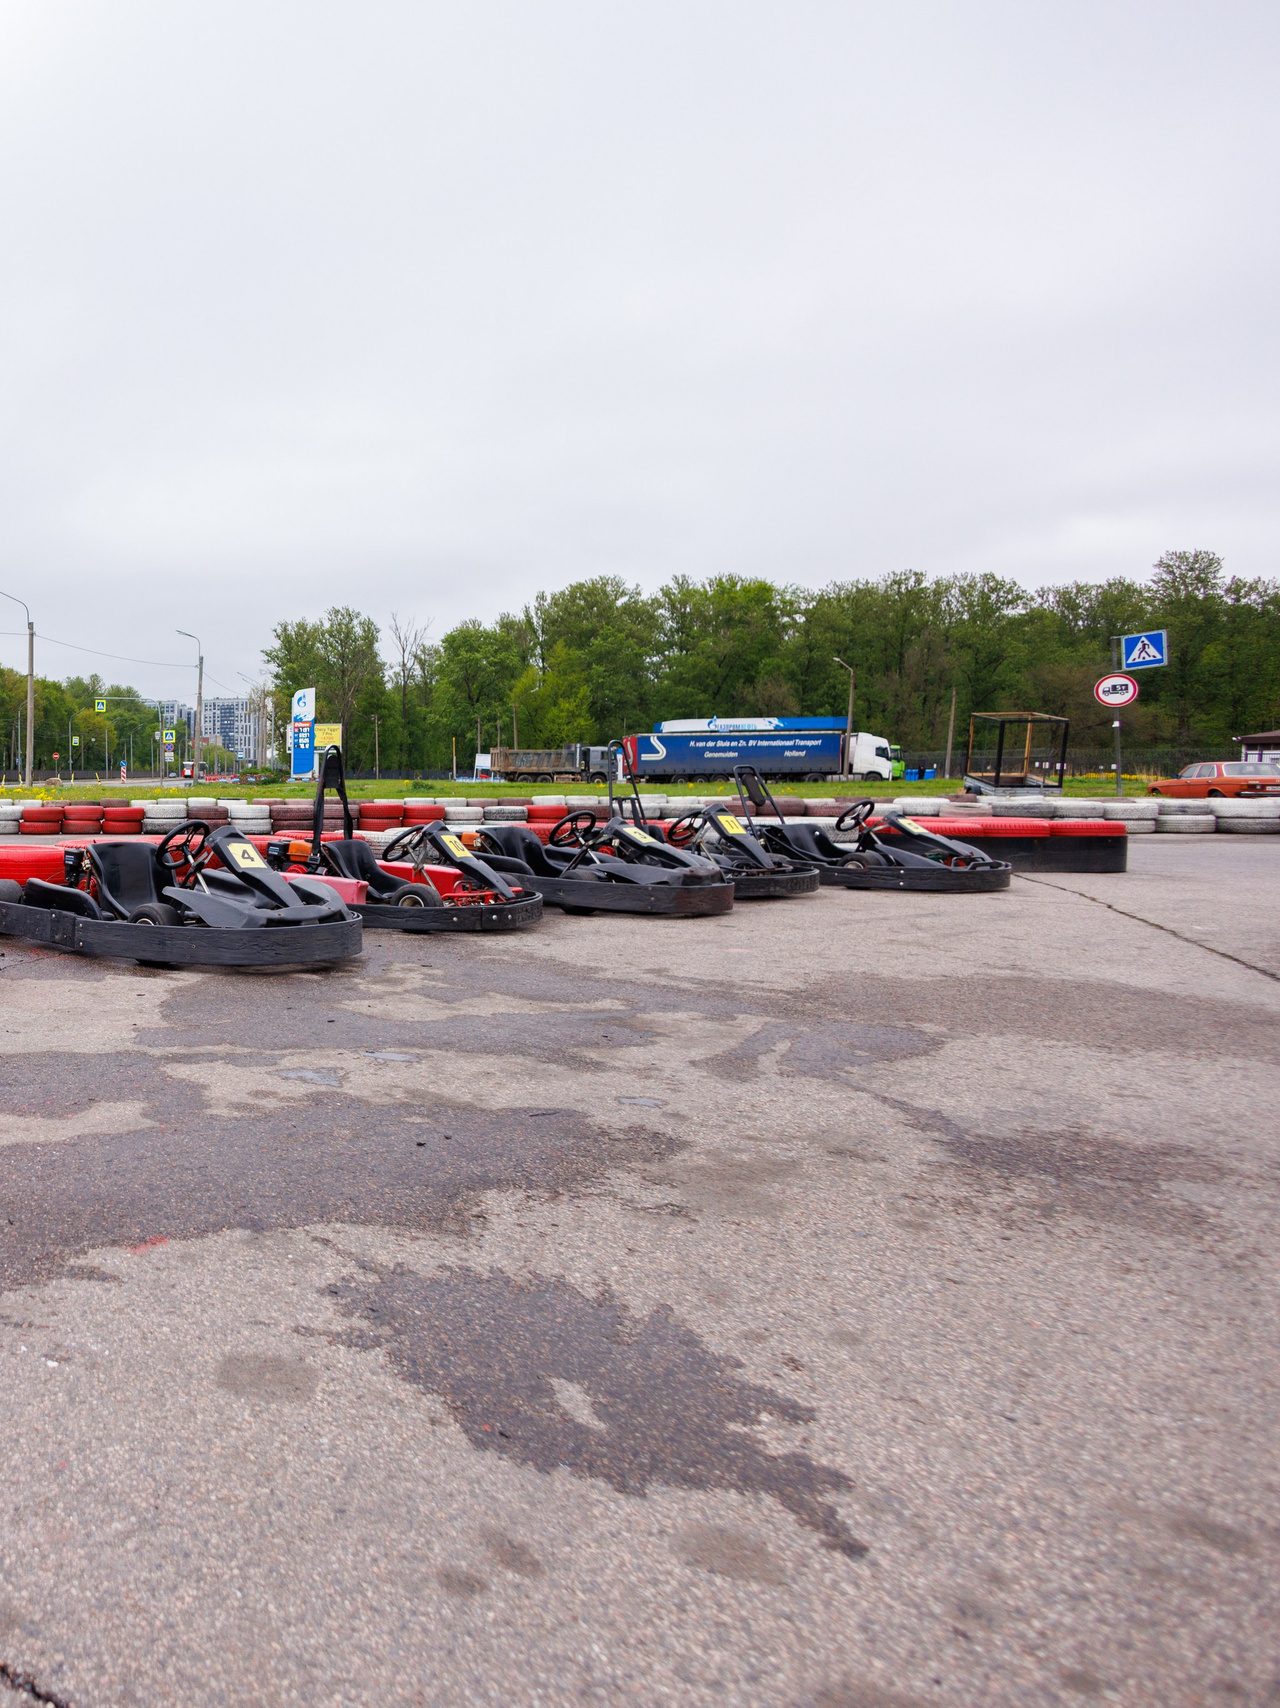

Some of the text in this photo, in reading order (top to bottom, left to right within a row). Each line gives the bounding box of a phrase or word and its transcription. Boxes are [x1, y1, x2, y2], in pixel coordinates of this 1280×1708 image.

[795, 739, 822, 747] Transport
[725, 819, 739, 829] 11
[449, 840, 465, 851] 10
[241, 849, 254, 861] 4
